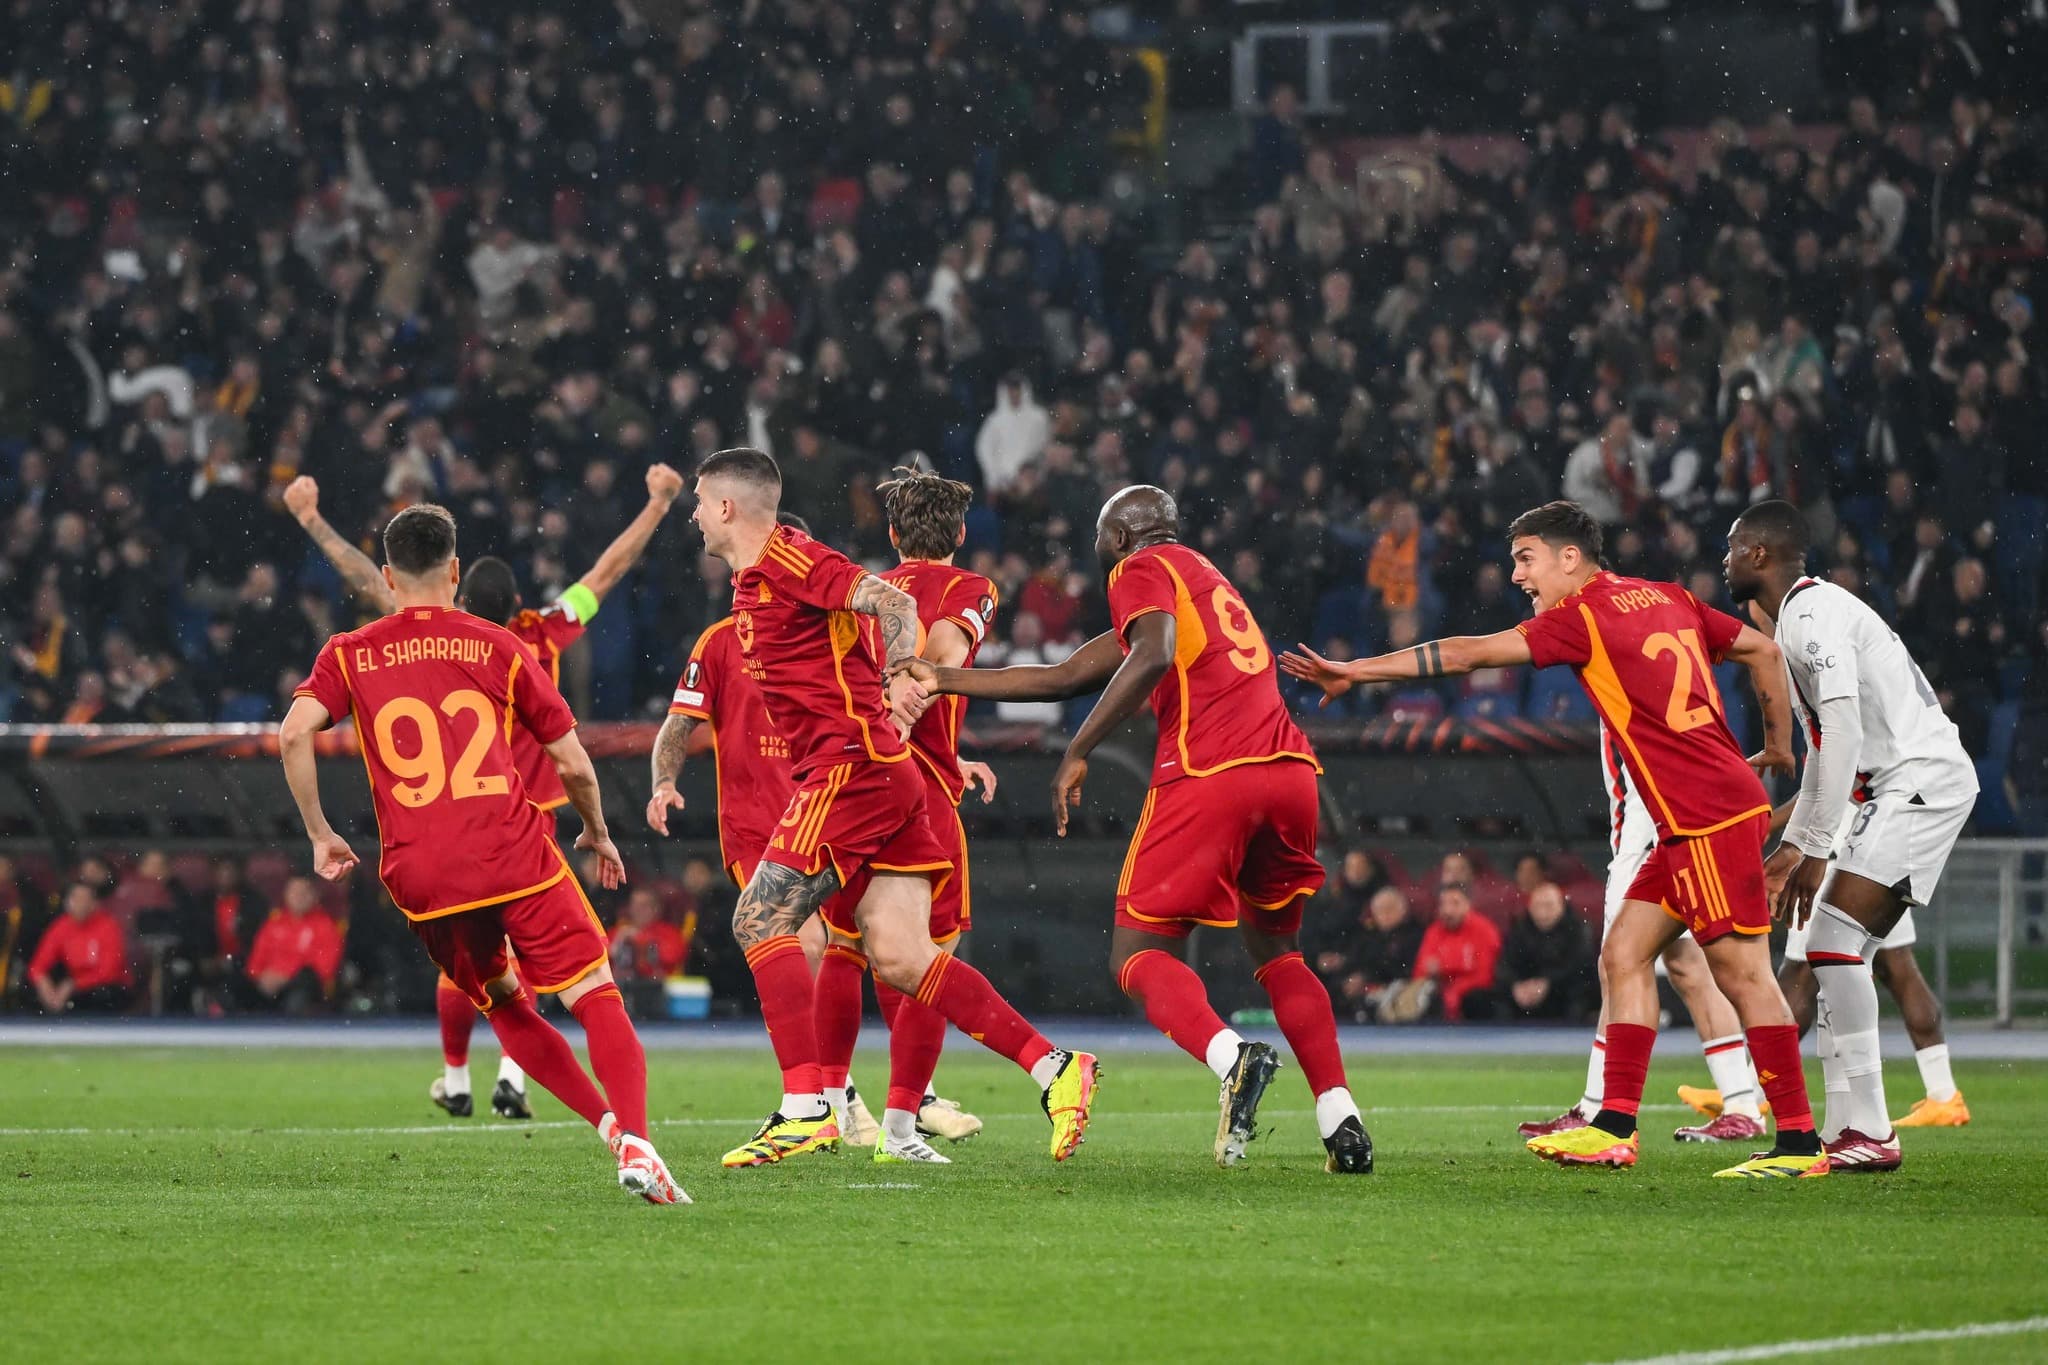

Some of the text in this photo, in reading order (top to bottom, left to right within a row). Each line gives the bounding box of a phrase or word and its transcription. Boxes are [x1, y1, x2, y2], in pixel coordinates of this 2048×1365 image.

[1211, 584, 1269, 675] 9
[1610, 587, 1675, 613] DYBALA
[355, 648, 378, 673] EL
[382, 637, 493, 667] SHAARAWY
[1641, 628, 1720, 733] 21
[373, 689, 510, 808] 92
